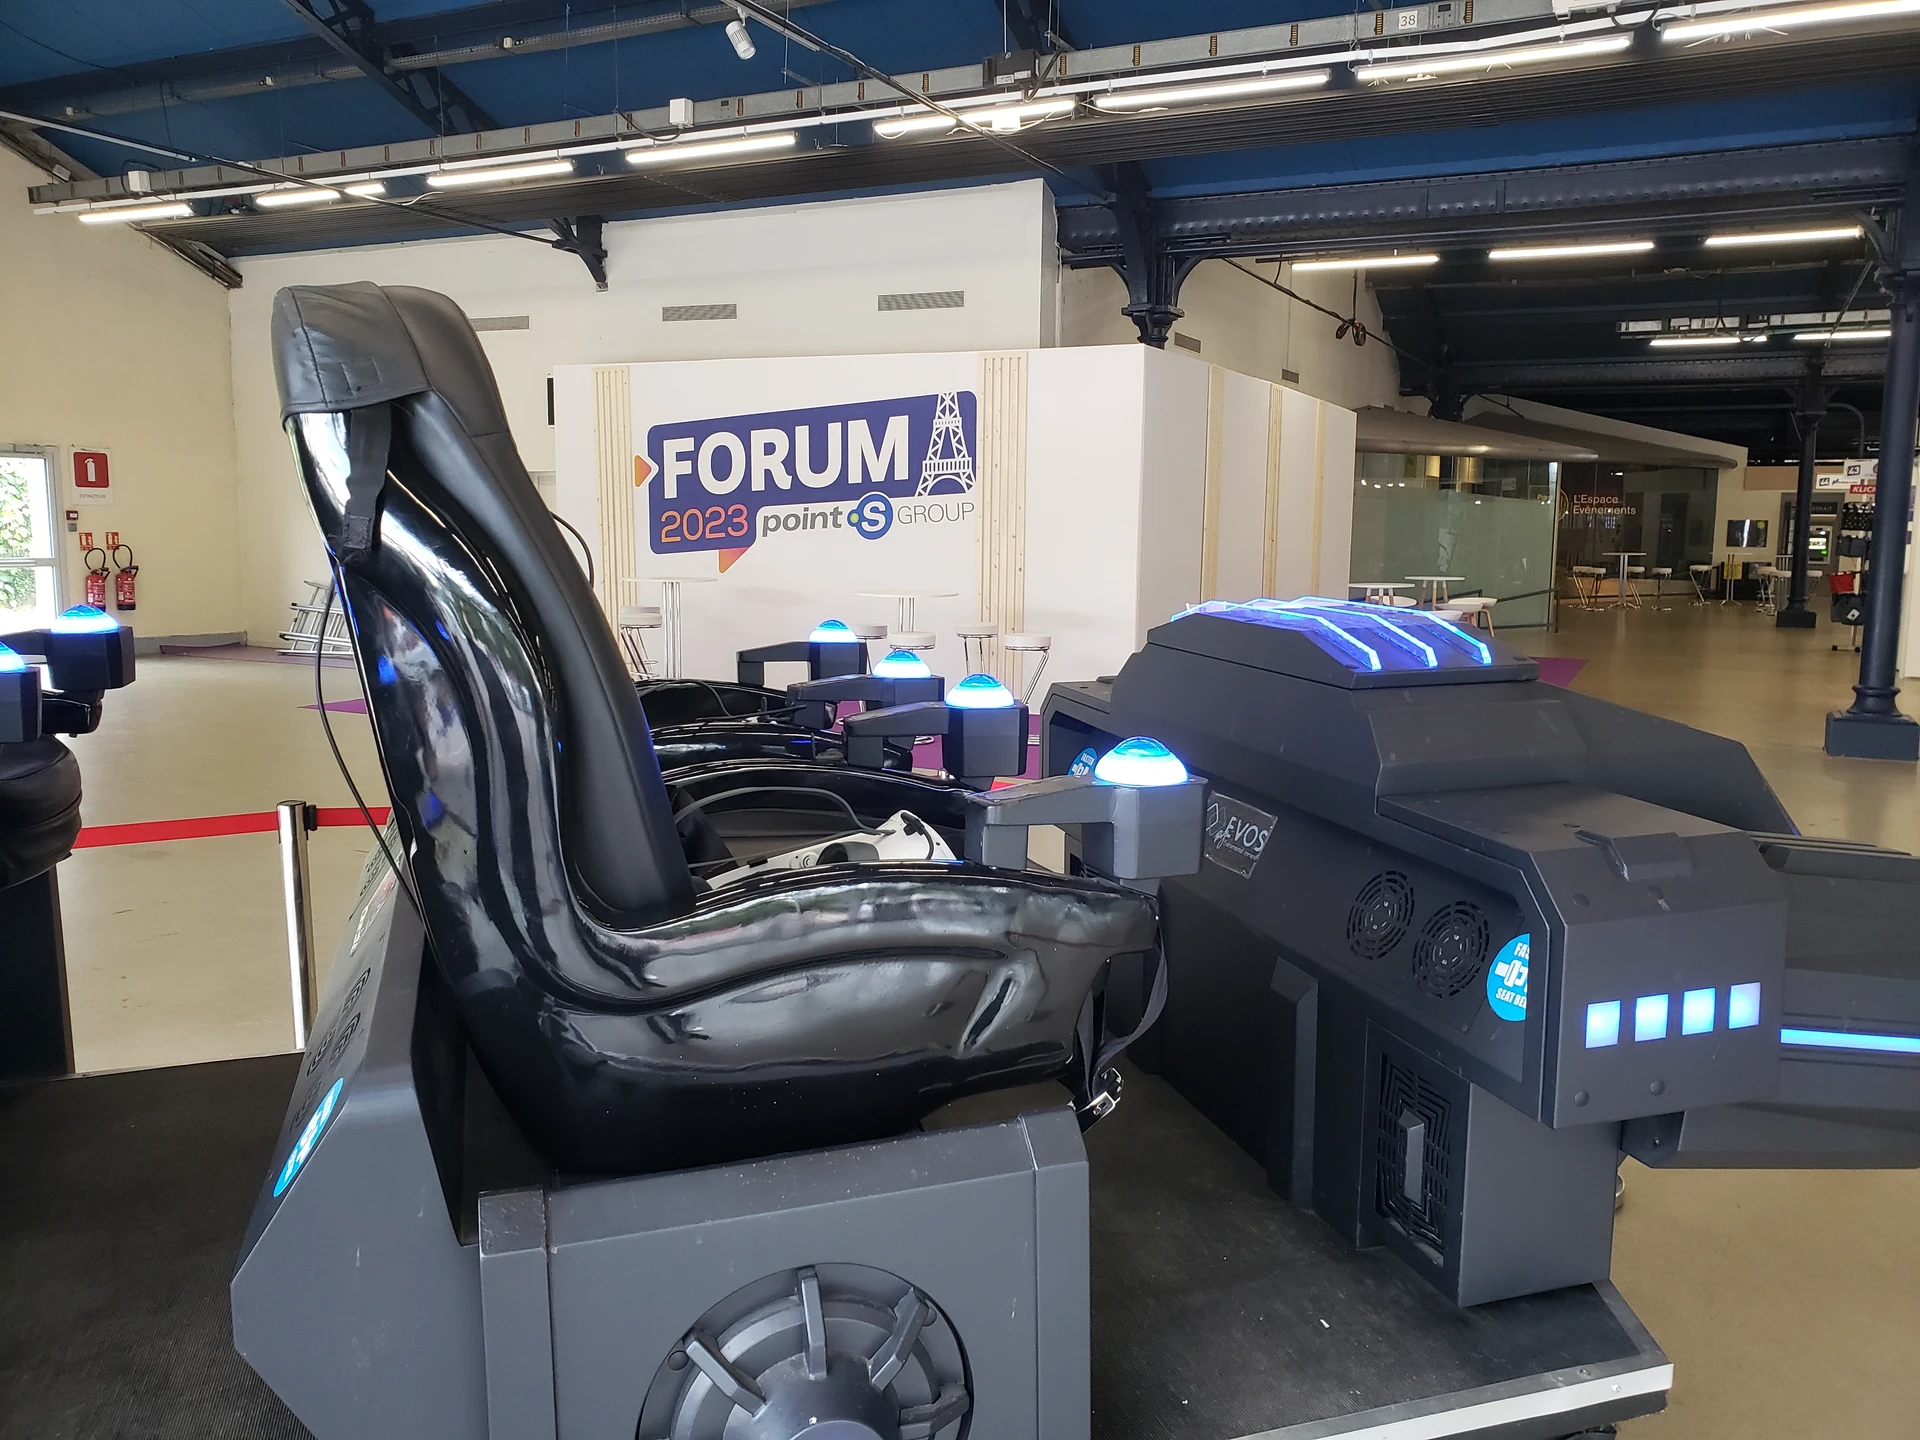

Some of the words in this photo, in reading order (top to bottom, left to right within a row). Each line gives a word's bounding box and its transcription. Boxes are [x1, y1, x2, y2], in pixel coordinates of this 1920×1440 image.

[1400, 14, 1416, 26] 38
[662, 414, 910, 499] FORUM
[1573, 494, 1619, 506] L'Espace
[661, 503, 749, 543] 2023
[762, 505, 843, 537] point
[897, 501, 975, 525] GROUP
[1224, 816, 1269, 852] EVOS
[1495, 987, 1516, 1004] SEAT
